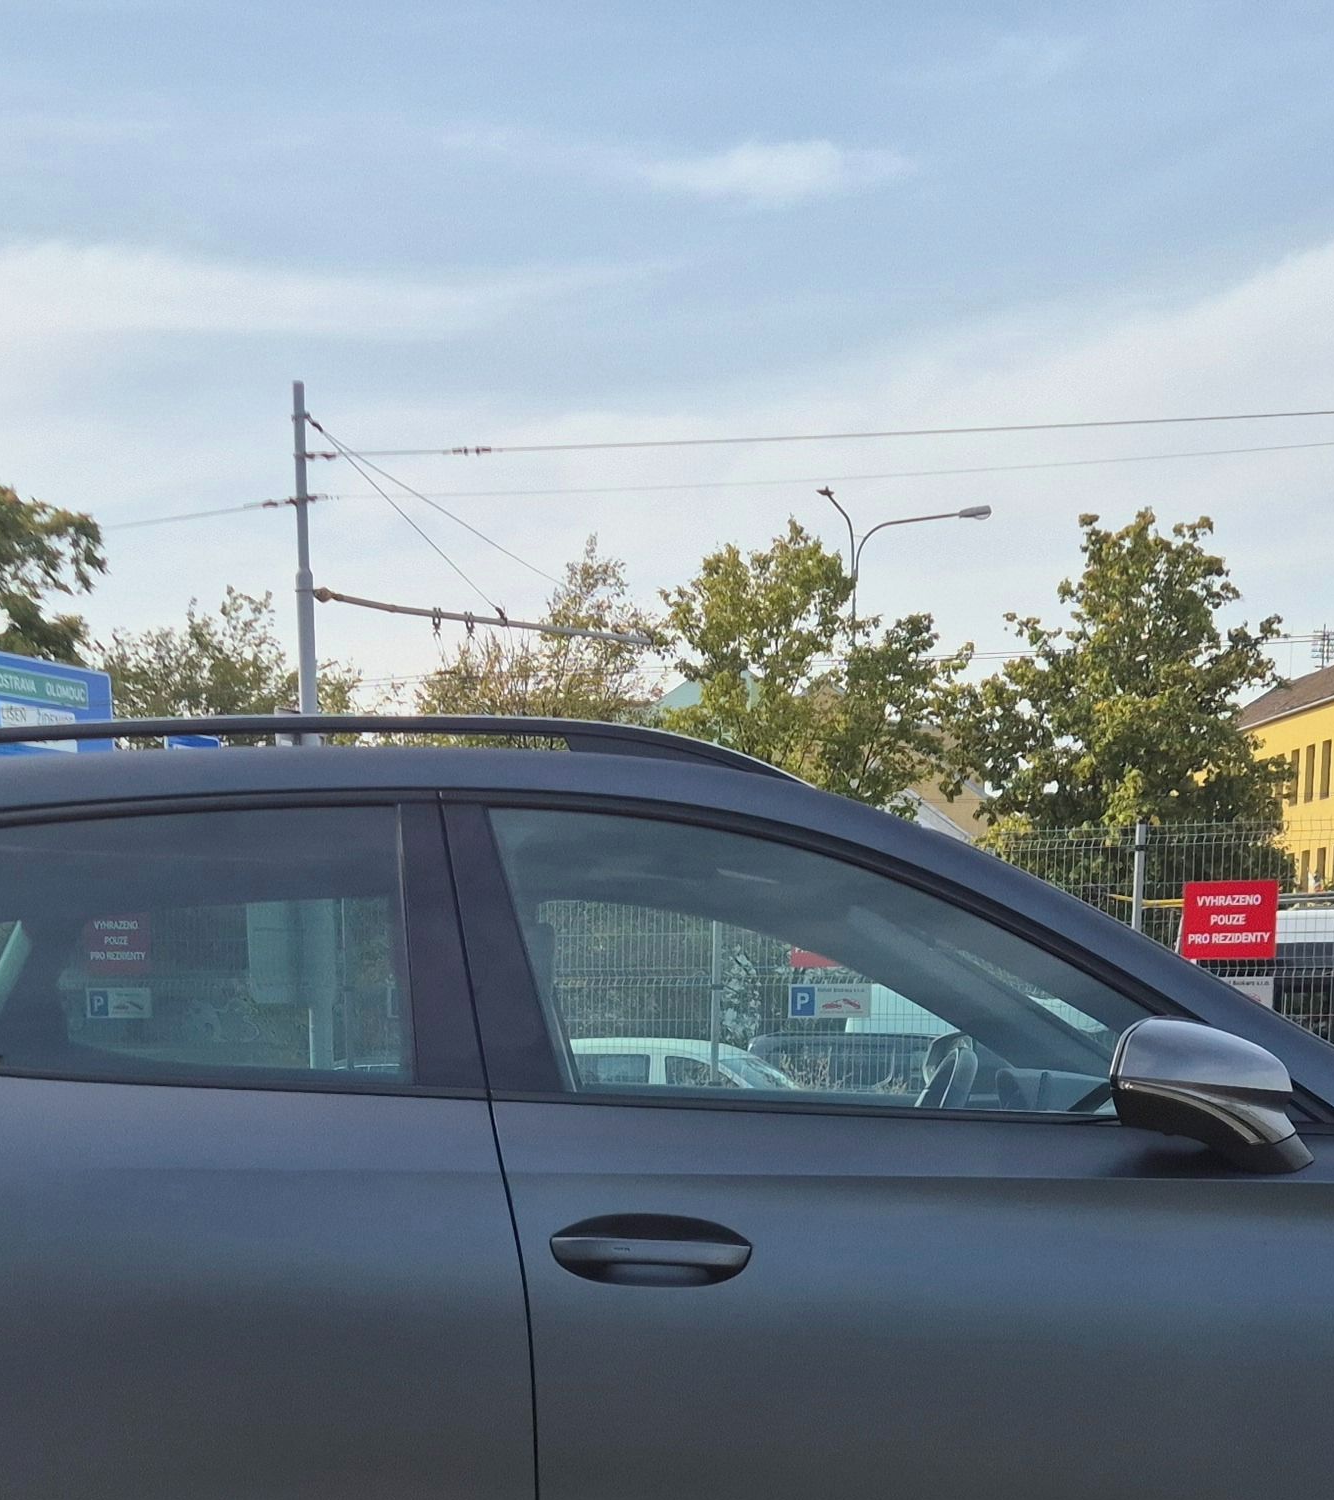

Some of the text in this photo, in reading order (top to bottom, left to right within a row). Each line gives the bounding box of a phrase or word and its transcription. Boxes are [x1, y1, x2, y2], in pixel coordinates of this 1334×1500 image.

[45, 682, 86, 702] OLOMOUC
[1196, 894, 1262, 907] VYHRAZENO
[94, 920, 138, 930] VYHRAZENO
[1210, 914, 1246, 926] POUZE
[104, 935, 129, 945] POUZE
[1188, 932, 1272, 945] PRO REZIDENTY
[90, 951, 105, 961] PRO
[93, 996, 104, 1012] P
[797, 992, 809, 1011] P
